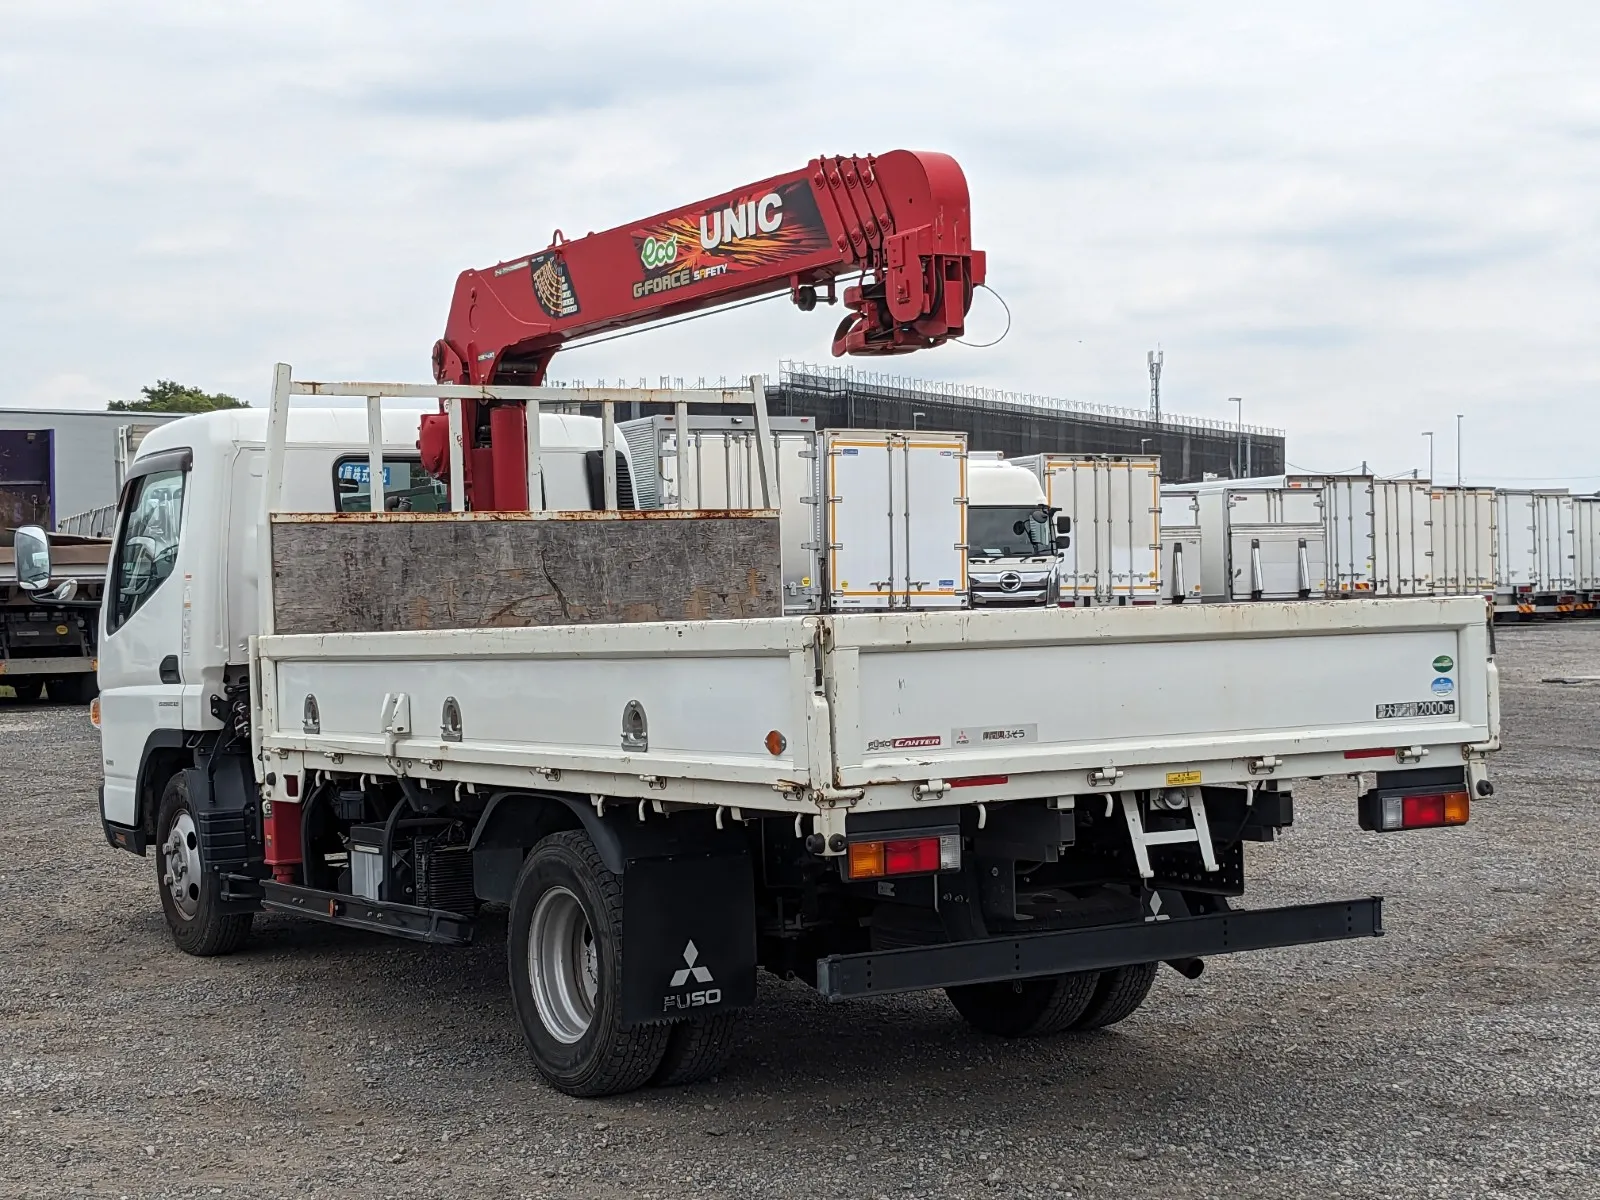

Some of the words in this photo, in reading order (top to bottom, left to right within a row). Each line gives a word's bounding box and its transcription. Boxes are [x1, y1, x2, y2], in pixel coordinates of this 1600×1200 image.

[700, 193, 782, 249] UNIC
[693, 263, 728, 281] SAFETY
[894, 738, 940, 748] CANTER
[663, 988, 722, 1012] FUSO
